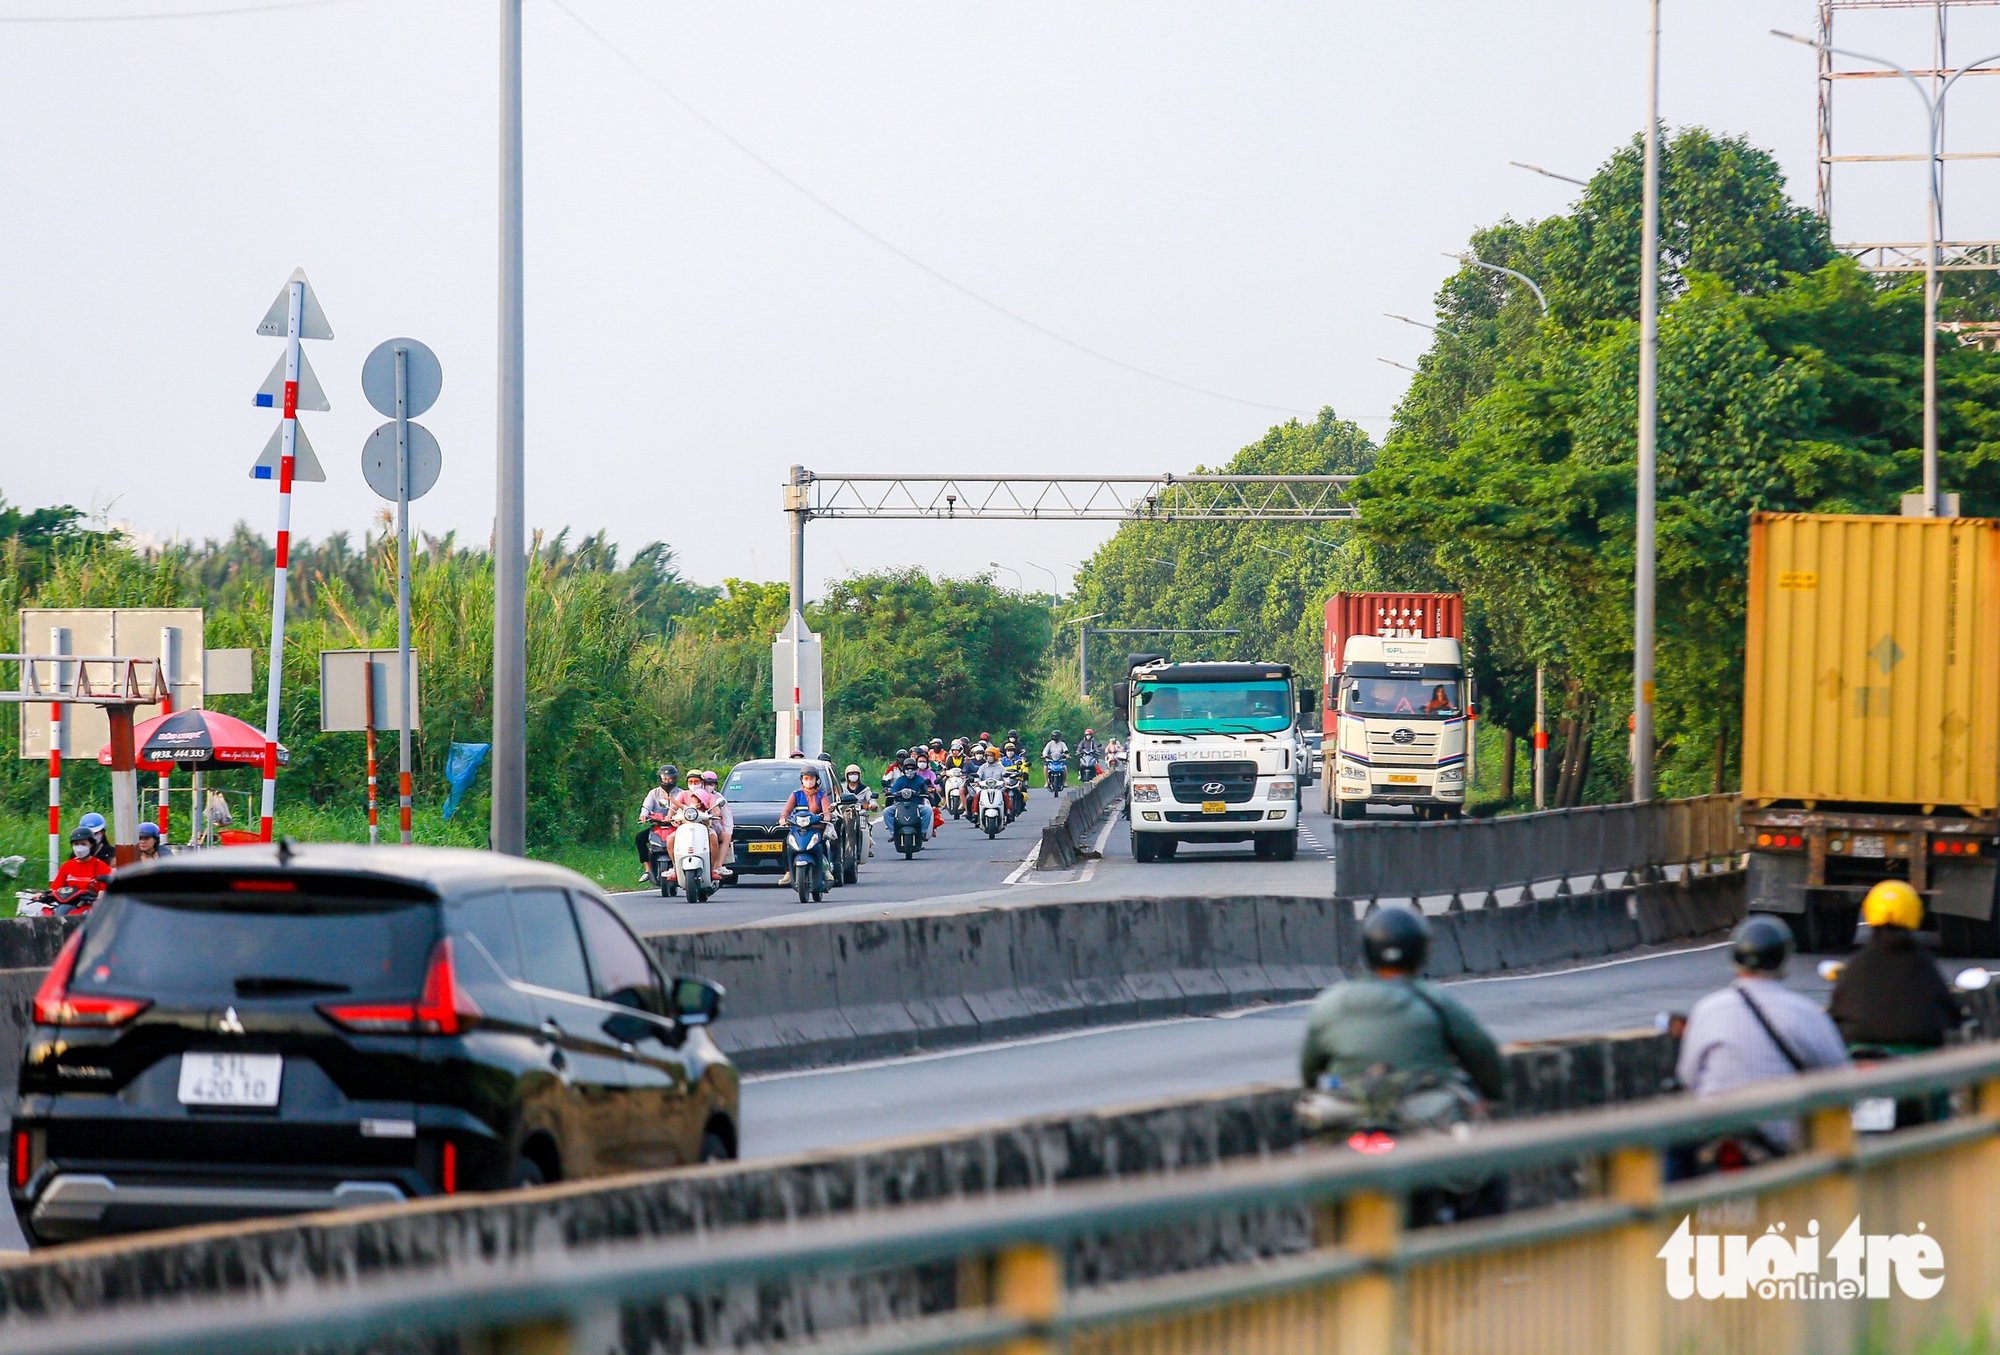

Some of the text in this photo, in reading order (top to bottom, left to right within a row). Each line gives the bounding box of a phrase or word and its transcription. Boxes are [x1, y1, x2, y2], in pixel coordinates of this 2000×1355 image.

[173, 749, 190, 758] 444
[189, 749, 205, 758] 333
[1178, 750, 1247, 759] HYUNDAI
